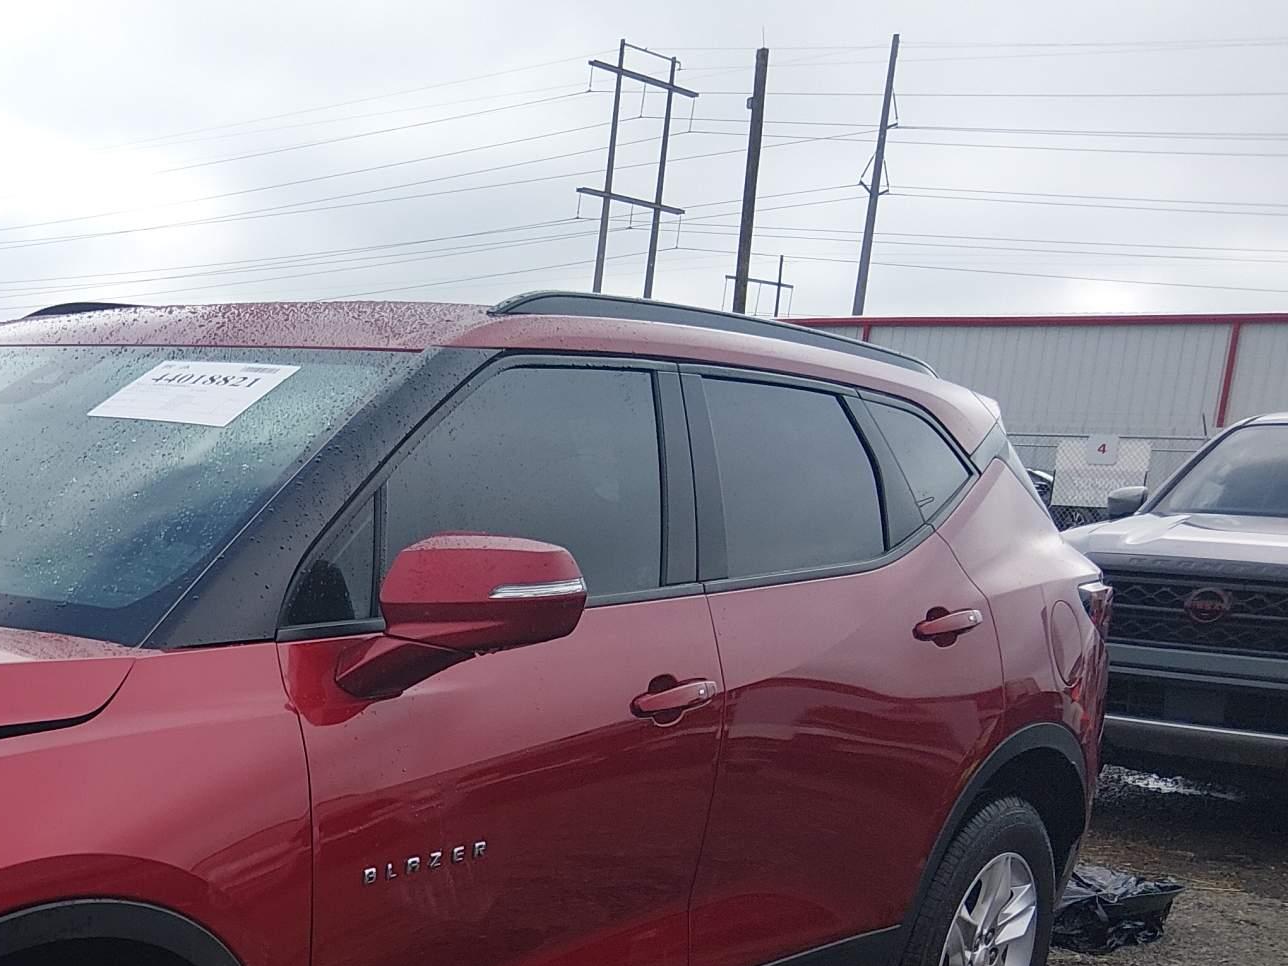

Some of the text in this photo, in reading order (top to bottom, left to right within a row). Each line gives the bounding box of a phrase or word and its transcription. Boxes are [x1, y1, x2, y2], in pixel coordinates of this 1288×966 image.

[152, 373, 260, 387] 44018821
[1097, 443, 1107, 454] 4
[364, 841, 487, 884] BLAZER
